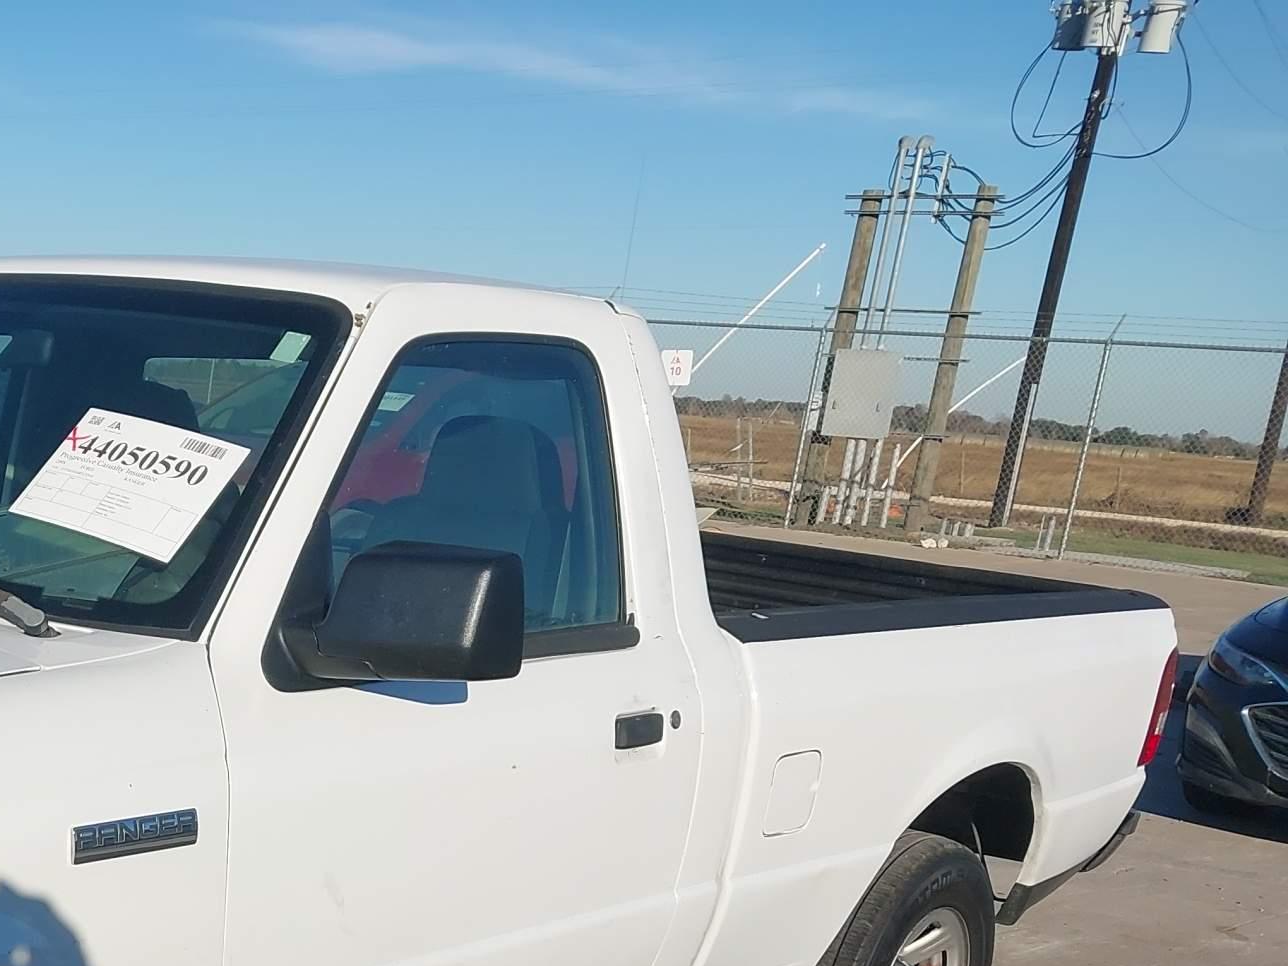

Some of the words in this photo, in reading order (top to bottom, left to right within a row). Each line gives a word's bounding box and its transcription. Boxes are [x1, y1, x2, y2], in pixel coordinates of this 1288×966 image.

[670, 366, 681, 376] 10
[61, 451, 97, 465] Progressive
[97, 460, 125, 474] Casualty
[125, 468, 158, 482] Insurance
[78, 436, 208, 485] 44050590
[75, 810, 196, 850] RANGER
